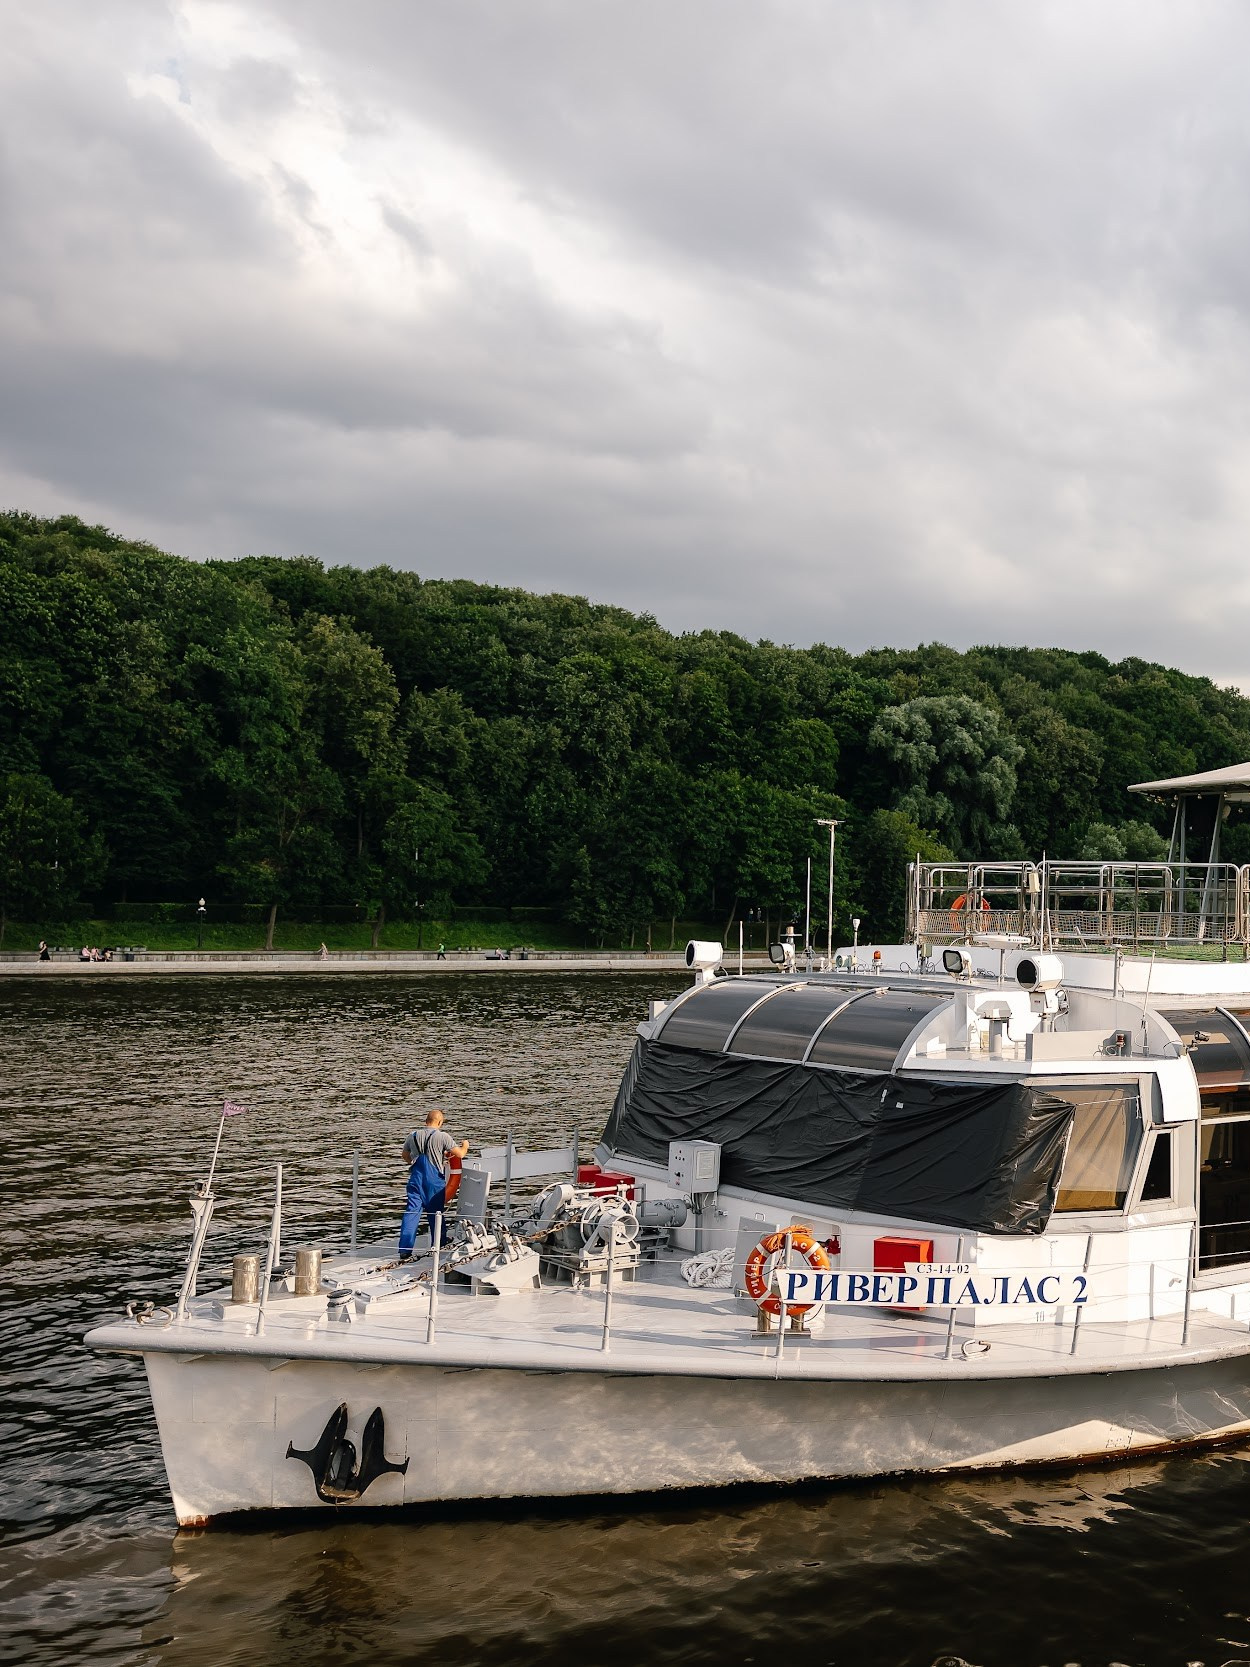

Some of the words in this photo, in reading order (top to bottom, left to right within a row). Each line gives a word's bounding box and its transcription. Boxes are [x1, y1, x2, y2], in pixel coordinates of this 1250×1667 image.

[751, 1256, 761, 1295] РИВЕР
[784, 1272, 918, 1304] РИВЕР
[925, 1276, 1060, 1305] ПАЛАС
[1072, 1275, 1089, 1304] 2
